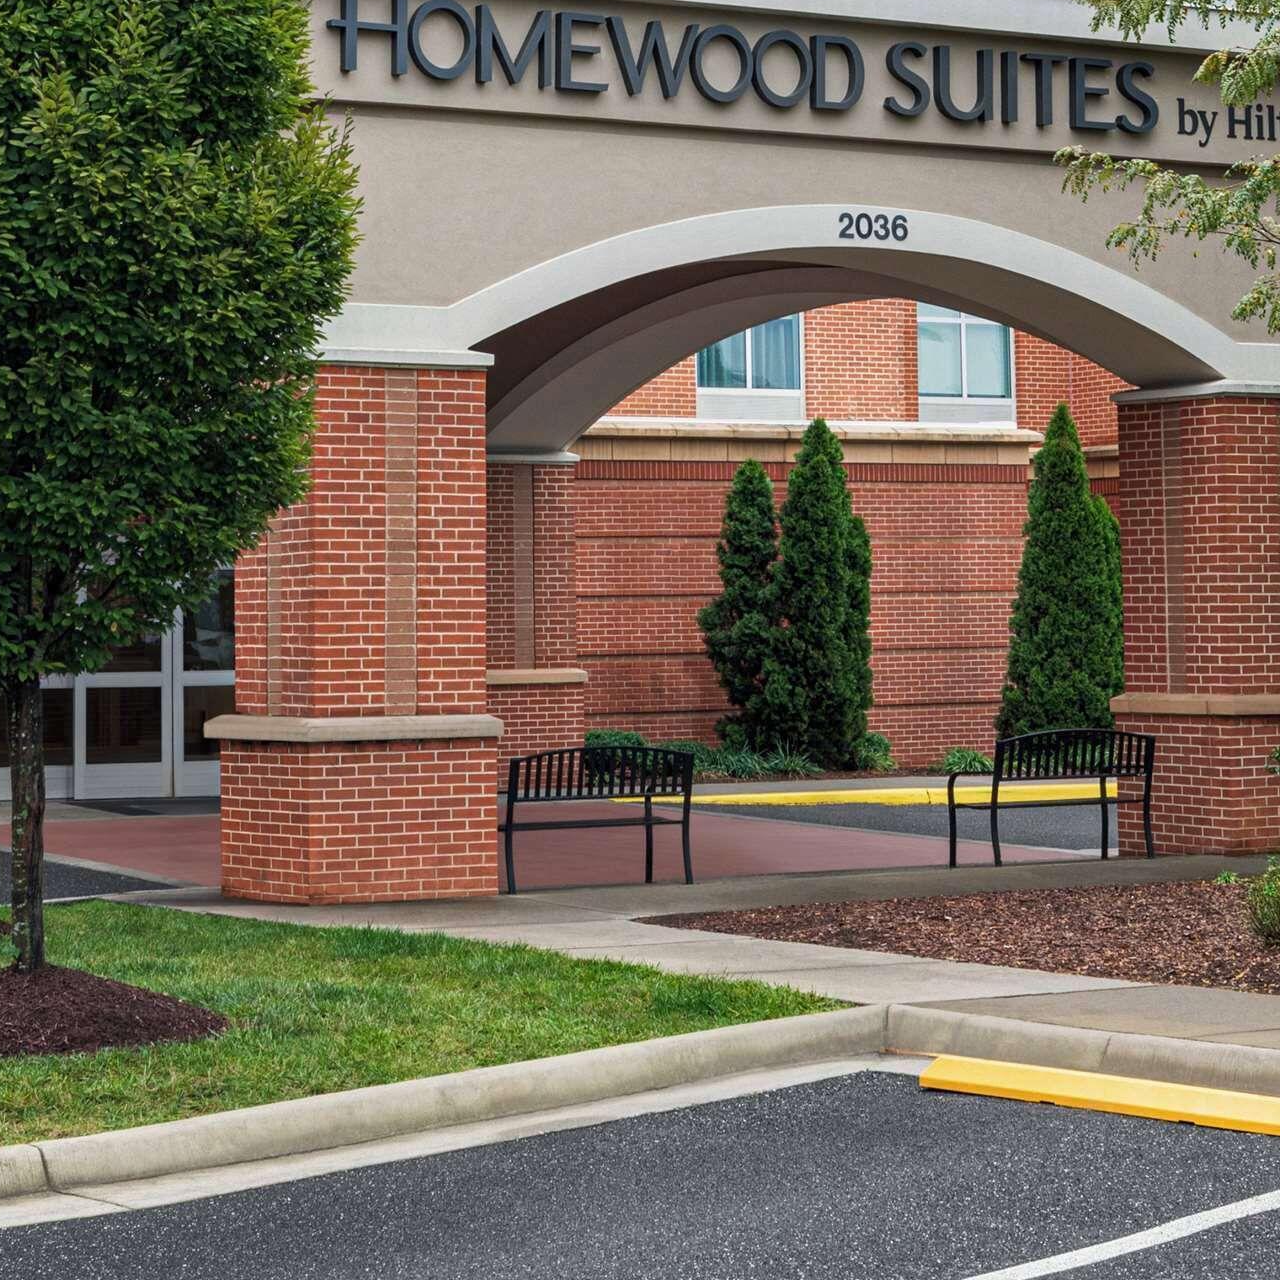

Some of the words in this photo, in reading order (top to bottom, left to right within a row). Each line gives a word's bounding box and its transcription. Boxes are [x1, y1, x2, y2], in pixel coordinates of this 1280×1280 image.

[884, 41, 1158, 134] SUITES
[1176, 97, 1218, 147] by
[838, 212, 908, 241] 2036
